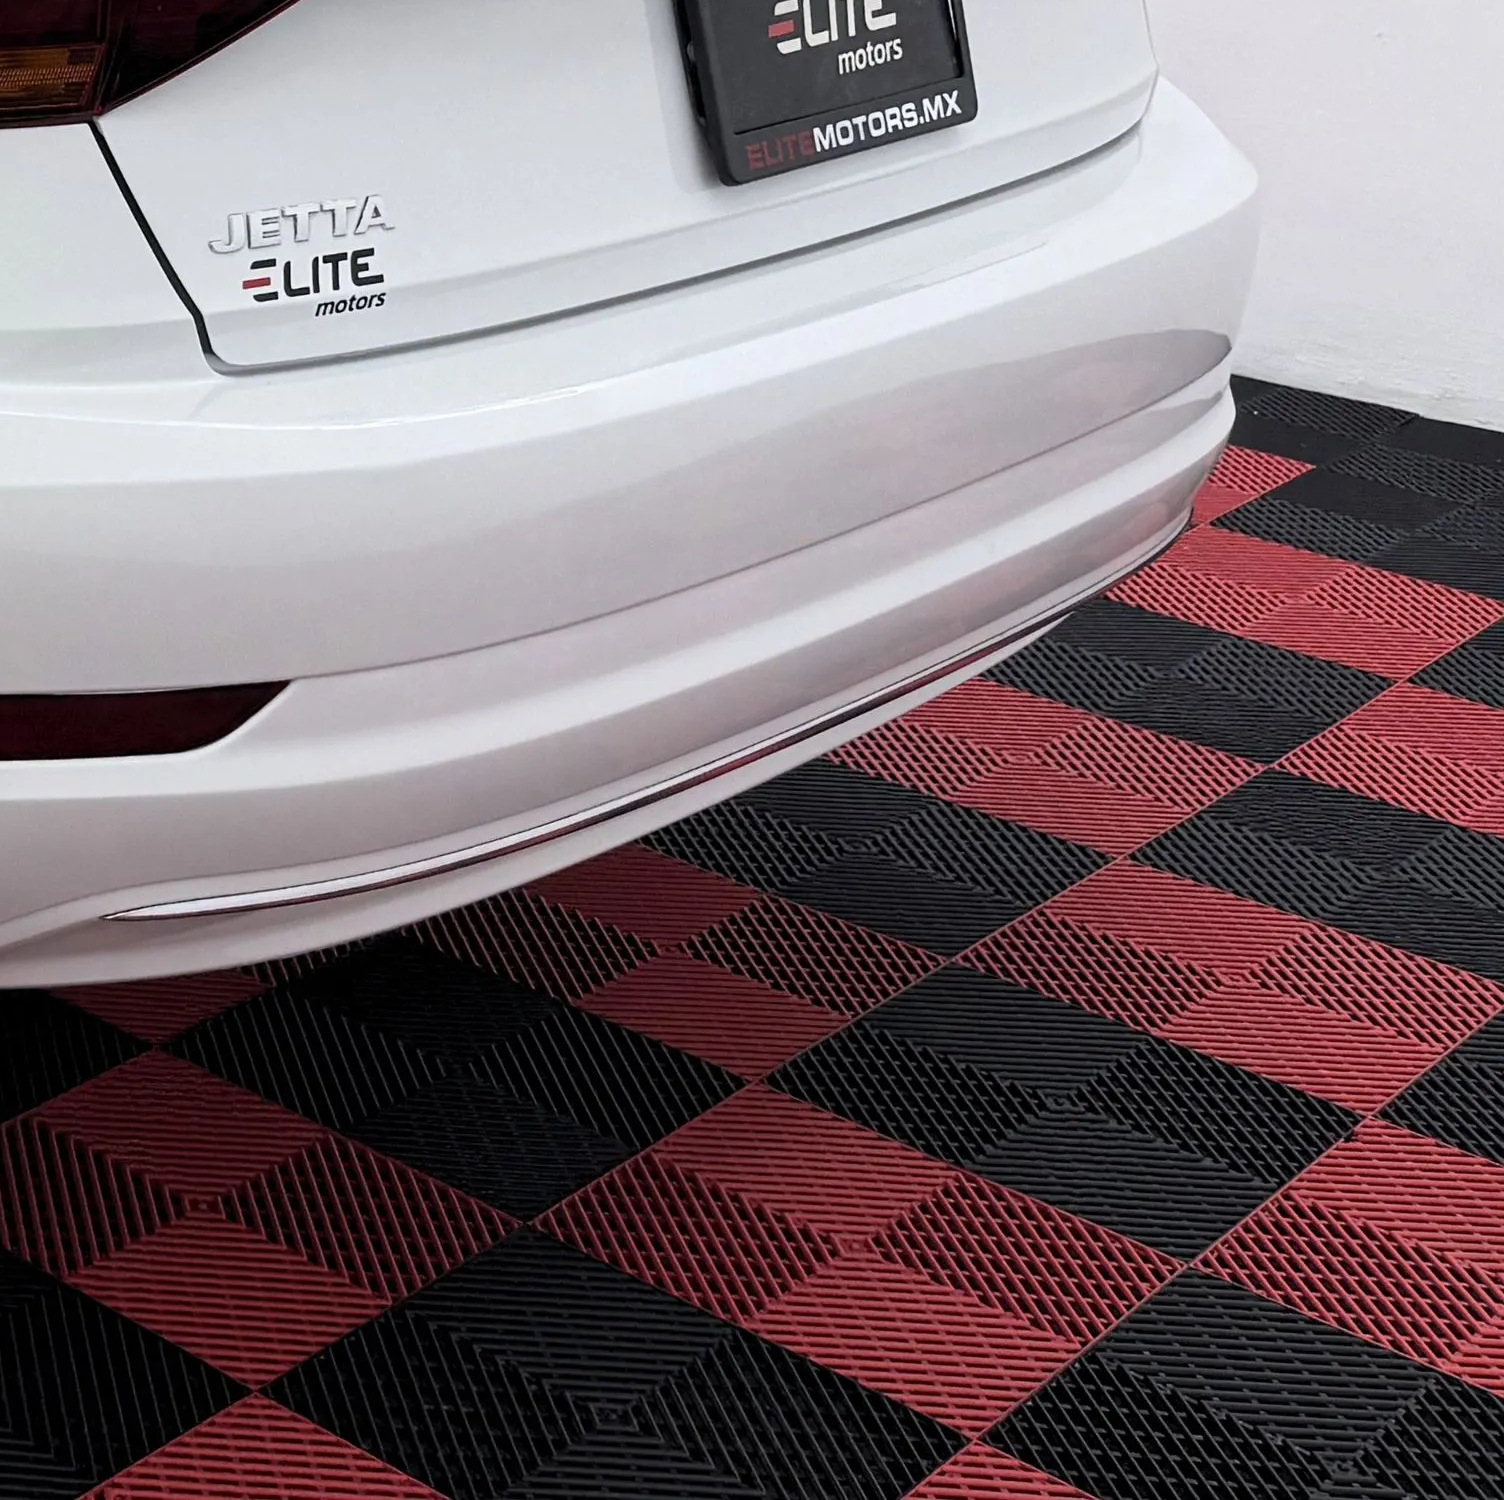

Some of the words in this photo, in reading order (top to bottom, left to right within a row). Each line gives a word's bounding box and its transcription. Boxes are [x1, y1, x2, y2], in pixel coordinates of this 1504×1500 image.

[838, 38, 903, 75] motors
[746, 90, 962, 171] ELITEMOTORS.MX
[208, 194, 395, 254] JETTA
[242, 247, 384, 302] ELITE
[315, 292, 387, 317] motors
